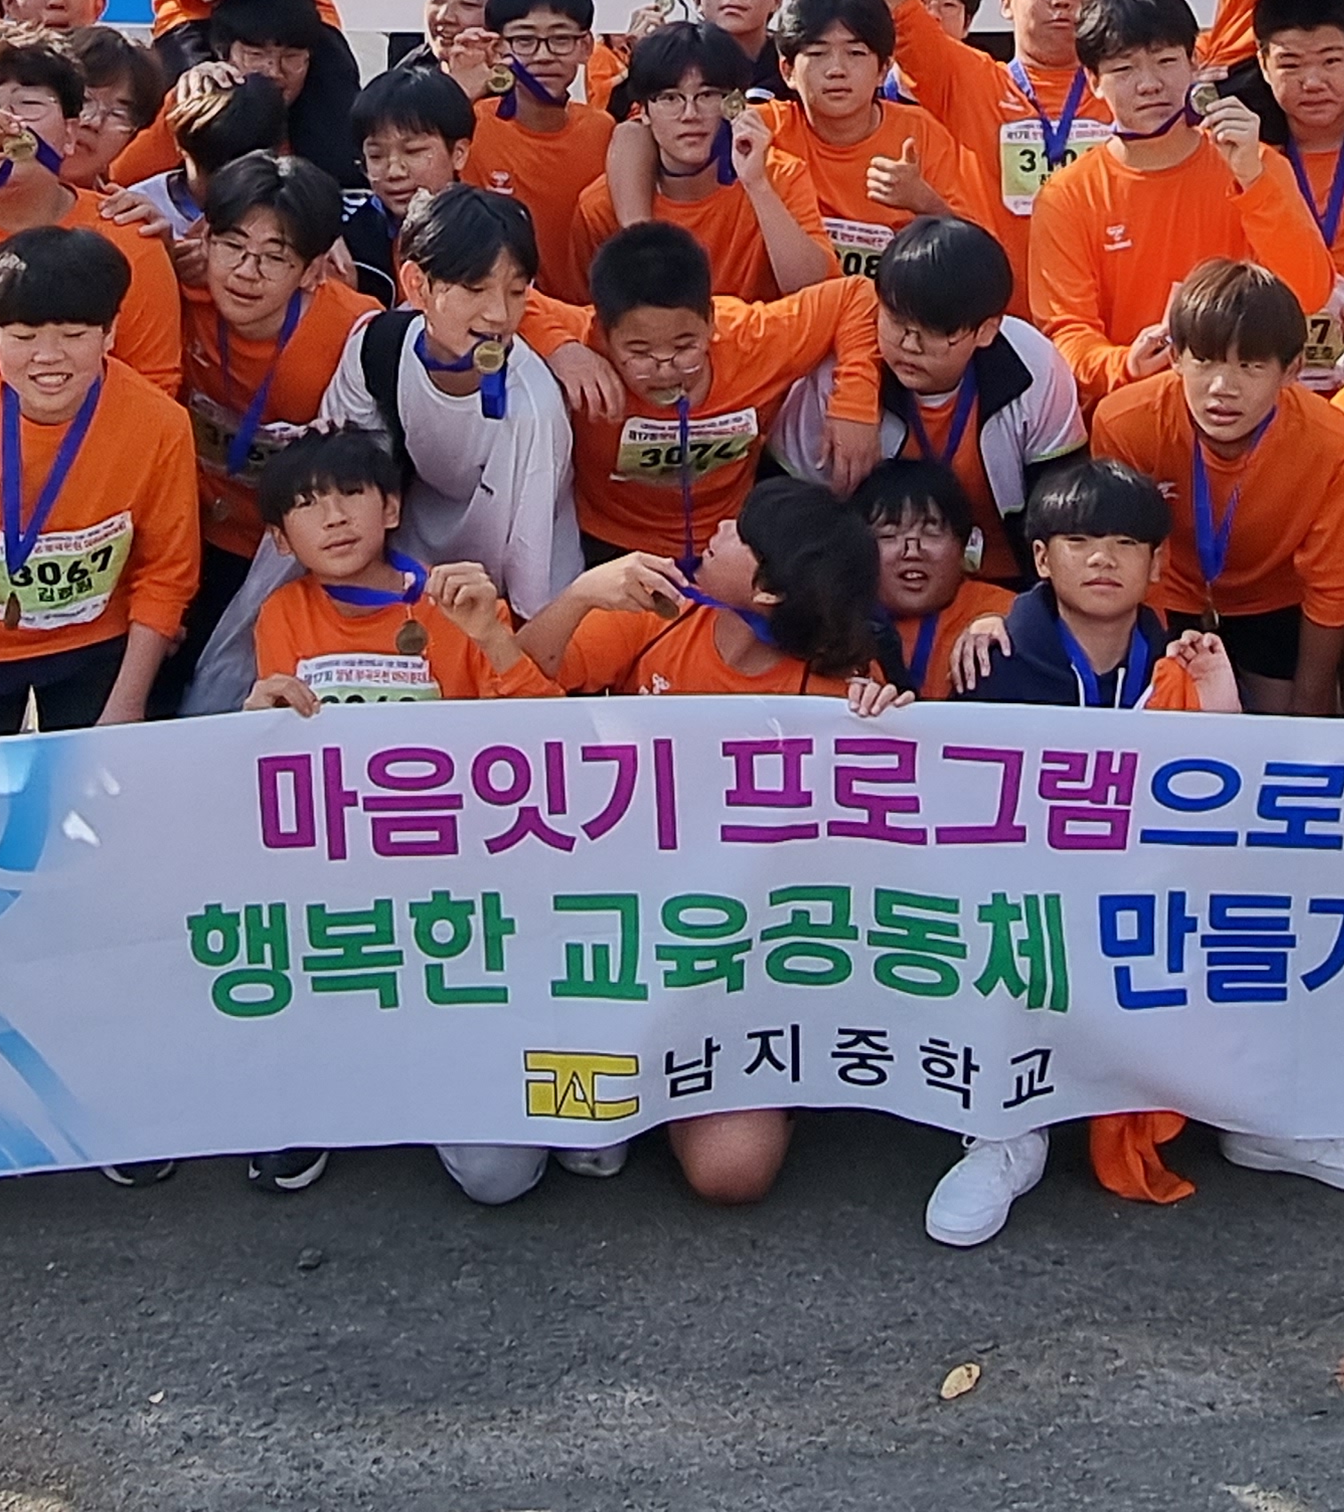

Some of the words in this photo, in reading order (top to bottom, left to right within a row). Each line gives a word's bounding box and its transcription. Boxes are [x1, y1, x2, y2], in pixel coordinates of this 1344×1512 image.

[1019, 147, 1094, 173] 310
[10, 544, 113, 587] 3067
[256, 737, 678, 861] 마음잇기
[186, 888, 516, 1018] 행복한
[550, 884, 1069, 1013] 교육공동체
[664, 1023, 1056, 1110] 남지중학교
